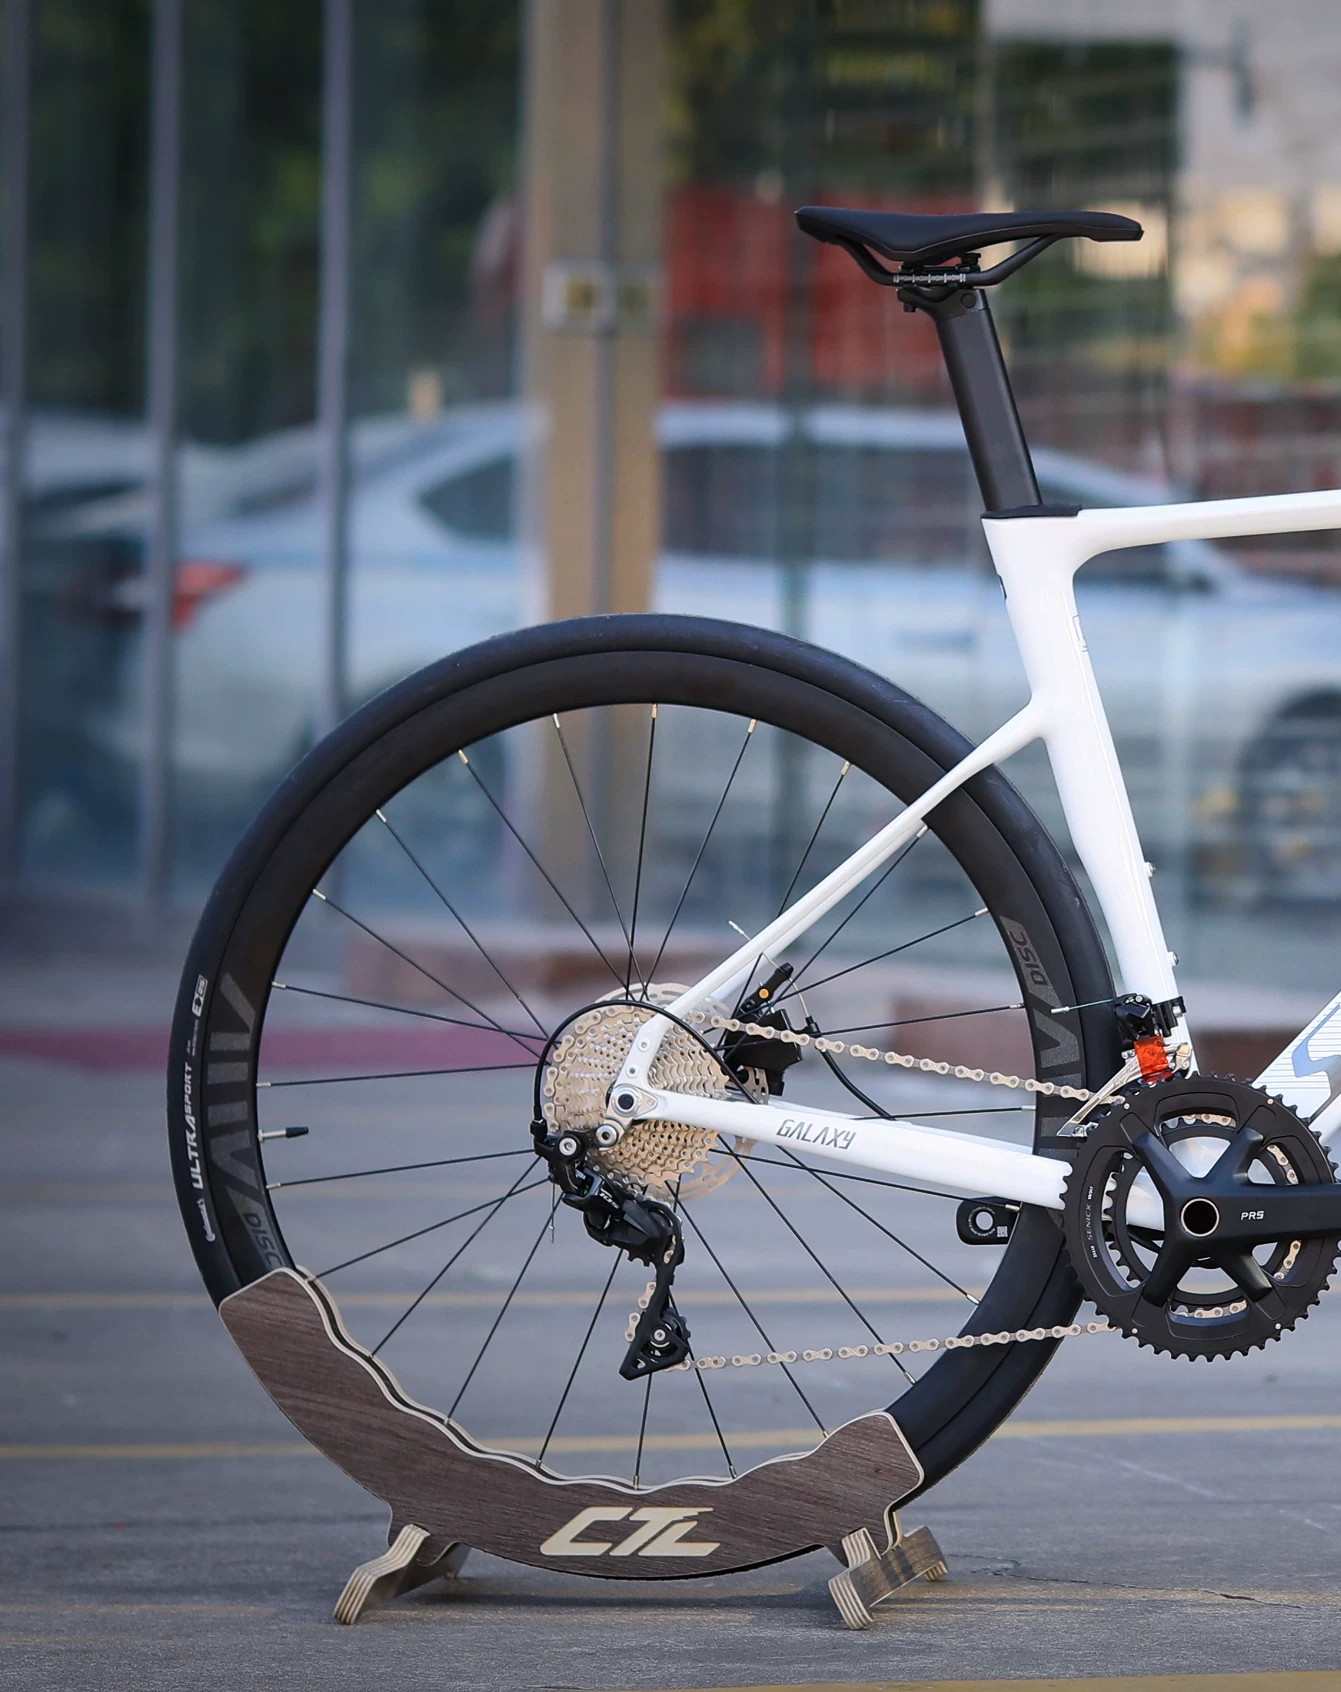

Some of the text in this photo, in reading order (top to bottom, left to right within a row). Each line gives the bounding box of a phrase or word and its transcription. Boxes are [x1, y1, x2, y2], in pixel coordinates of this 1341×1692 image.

[1010, 931, 1047, 986] DISC
[776, 1119, 856, 1150] GALAXY
[244, 1212, 282, 1269] DISC
[539, 1506, 721, 1557] CTL
